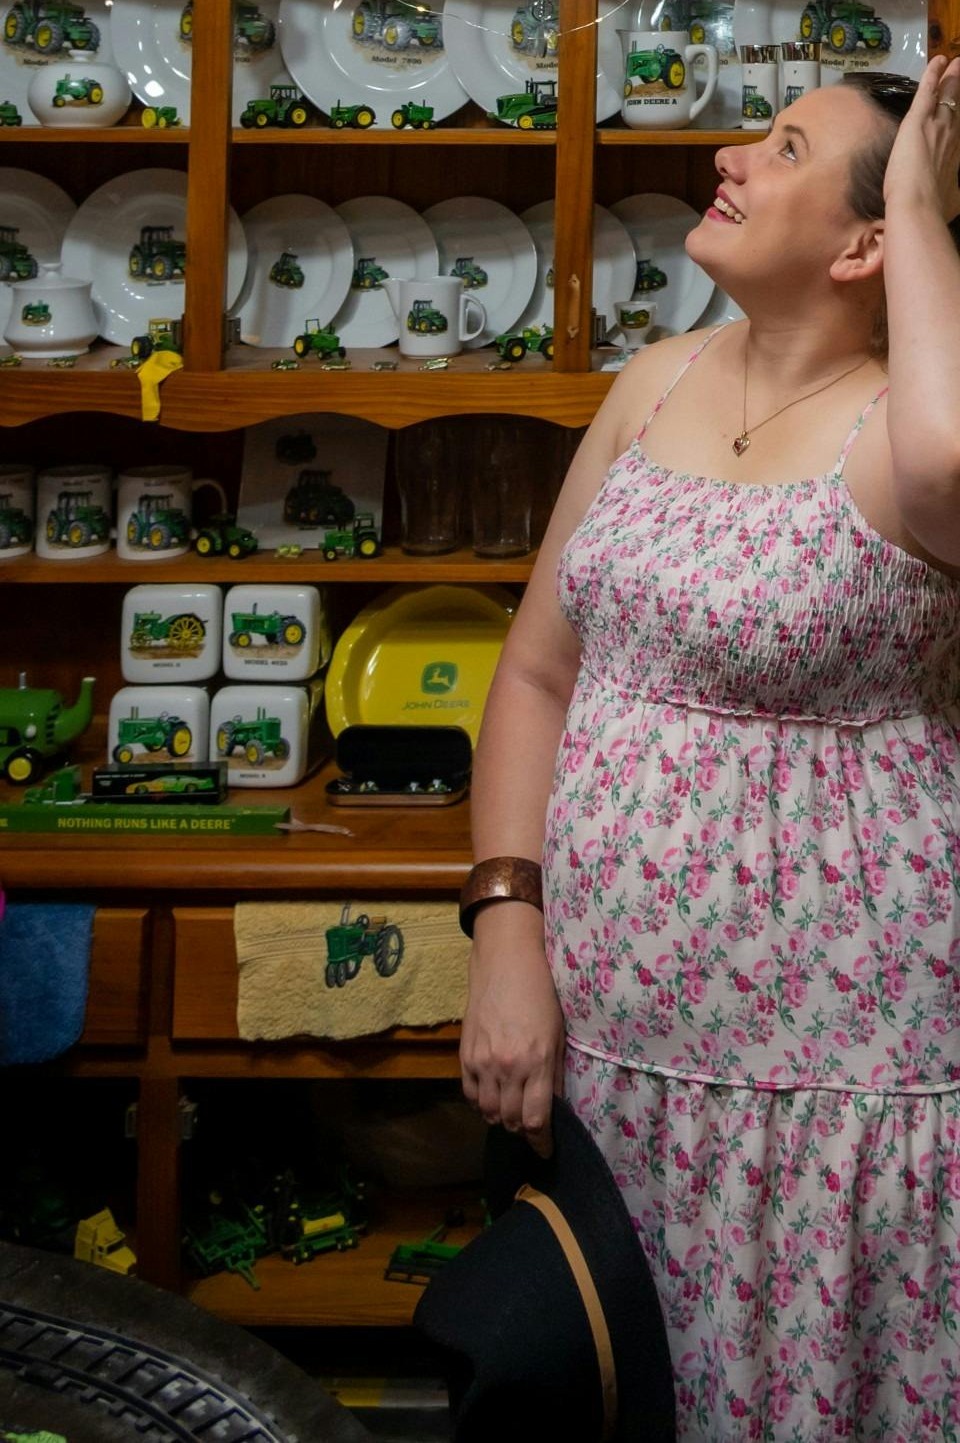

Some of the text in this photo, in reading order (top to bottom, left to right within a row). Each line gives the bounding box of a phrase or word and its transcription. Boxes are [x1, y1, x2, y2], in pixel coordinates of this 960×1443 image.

[371, 55, 397, 64] Model
[820, 58, 845, 67] Model
[535, 62, 559, 70] Mode
[626, 98, 642, 107] JOHN
[643, 98, 671, 106] DEERE
[400, 699, 470, 711] JOHN DEERE
[57, 817, 231, 830] NOTHING RUNS LIKE A DEERE
